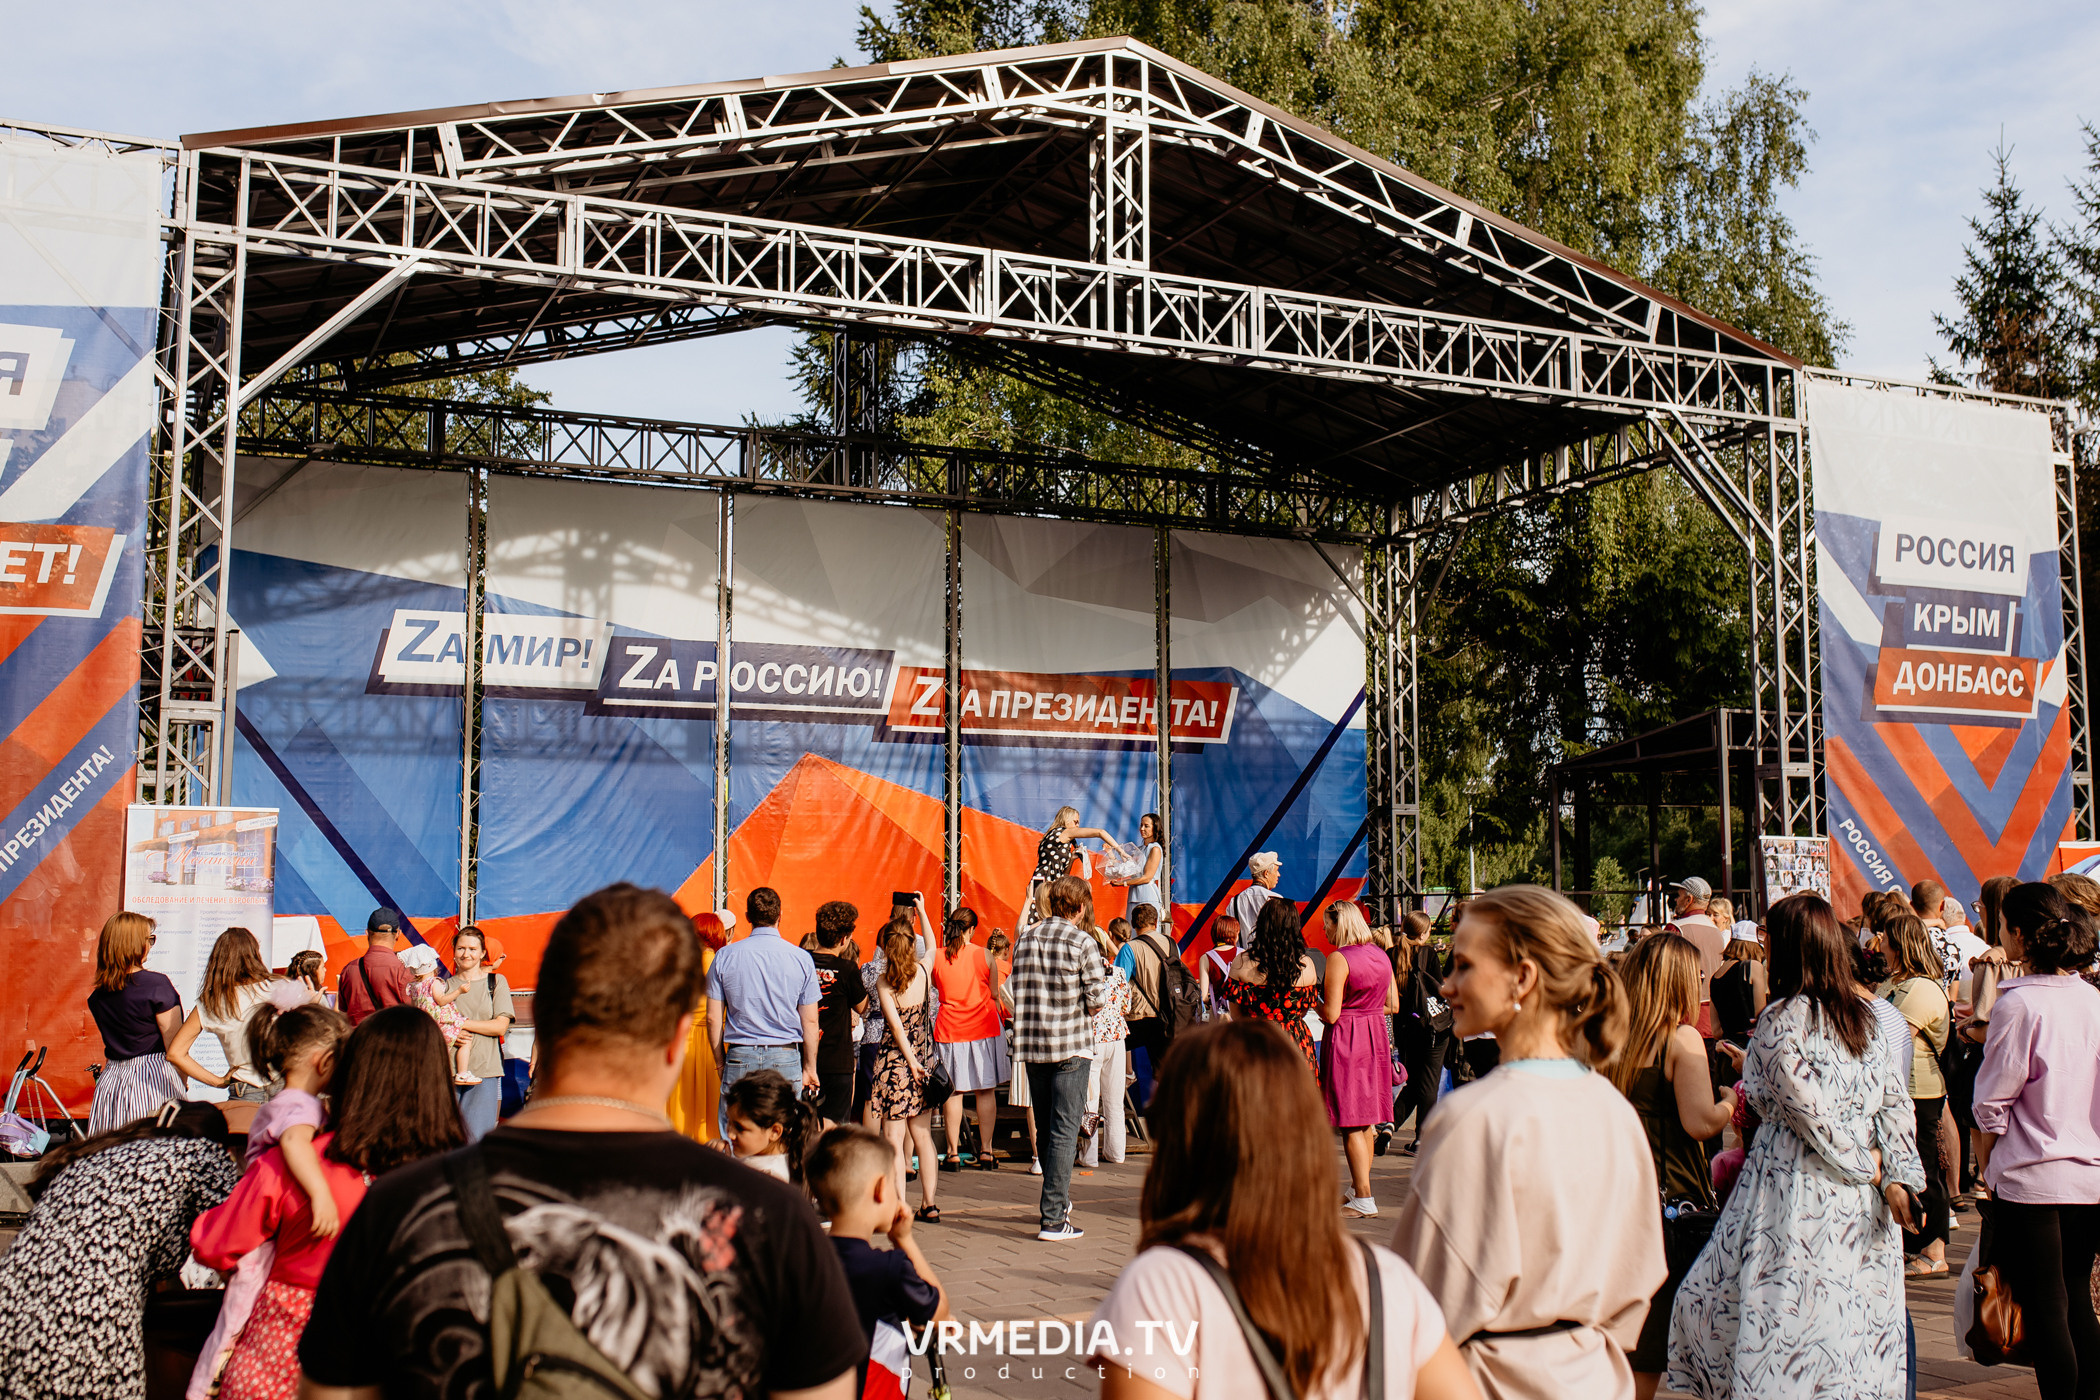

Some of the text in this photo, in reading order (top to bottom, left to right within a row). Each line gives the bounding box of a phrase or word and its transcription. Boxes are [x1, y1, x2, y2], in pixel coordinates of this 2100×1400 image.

[1895, 533, 2015, 574] РОССИЯ
[1913, 603, 2000, 638] КРЫМ
[486, 634, 594, 669] МИР!
[693, 660, 884, 698] РОССИЮ!
[988, 690, 1219, 729] ПРЕЗИДЕНТА!
[1892, 661, 2025, 697] ДОНБАСС
[1838, 818, 1895, 886] РОССИЯ
[132, 896, 188, 904] ОБСЛЕДОВАНИЕ
[189, 896, 195, 904] И
[196, 896, 227, 904] ЛЕЧЕНИЕ
